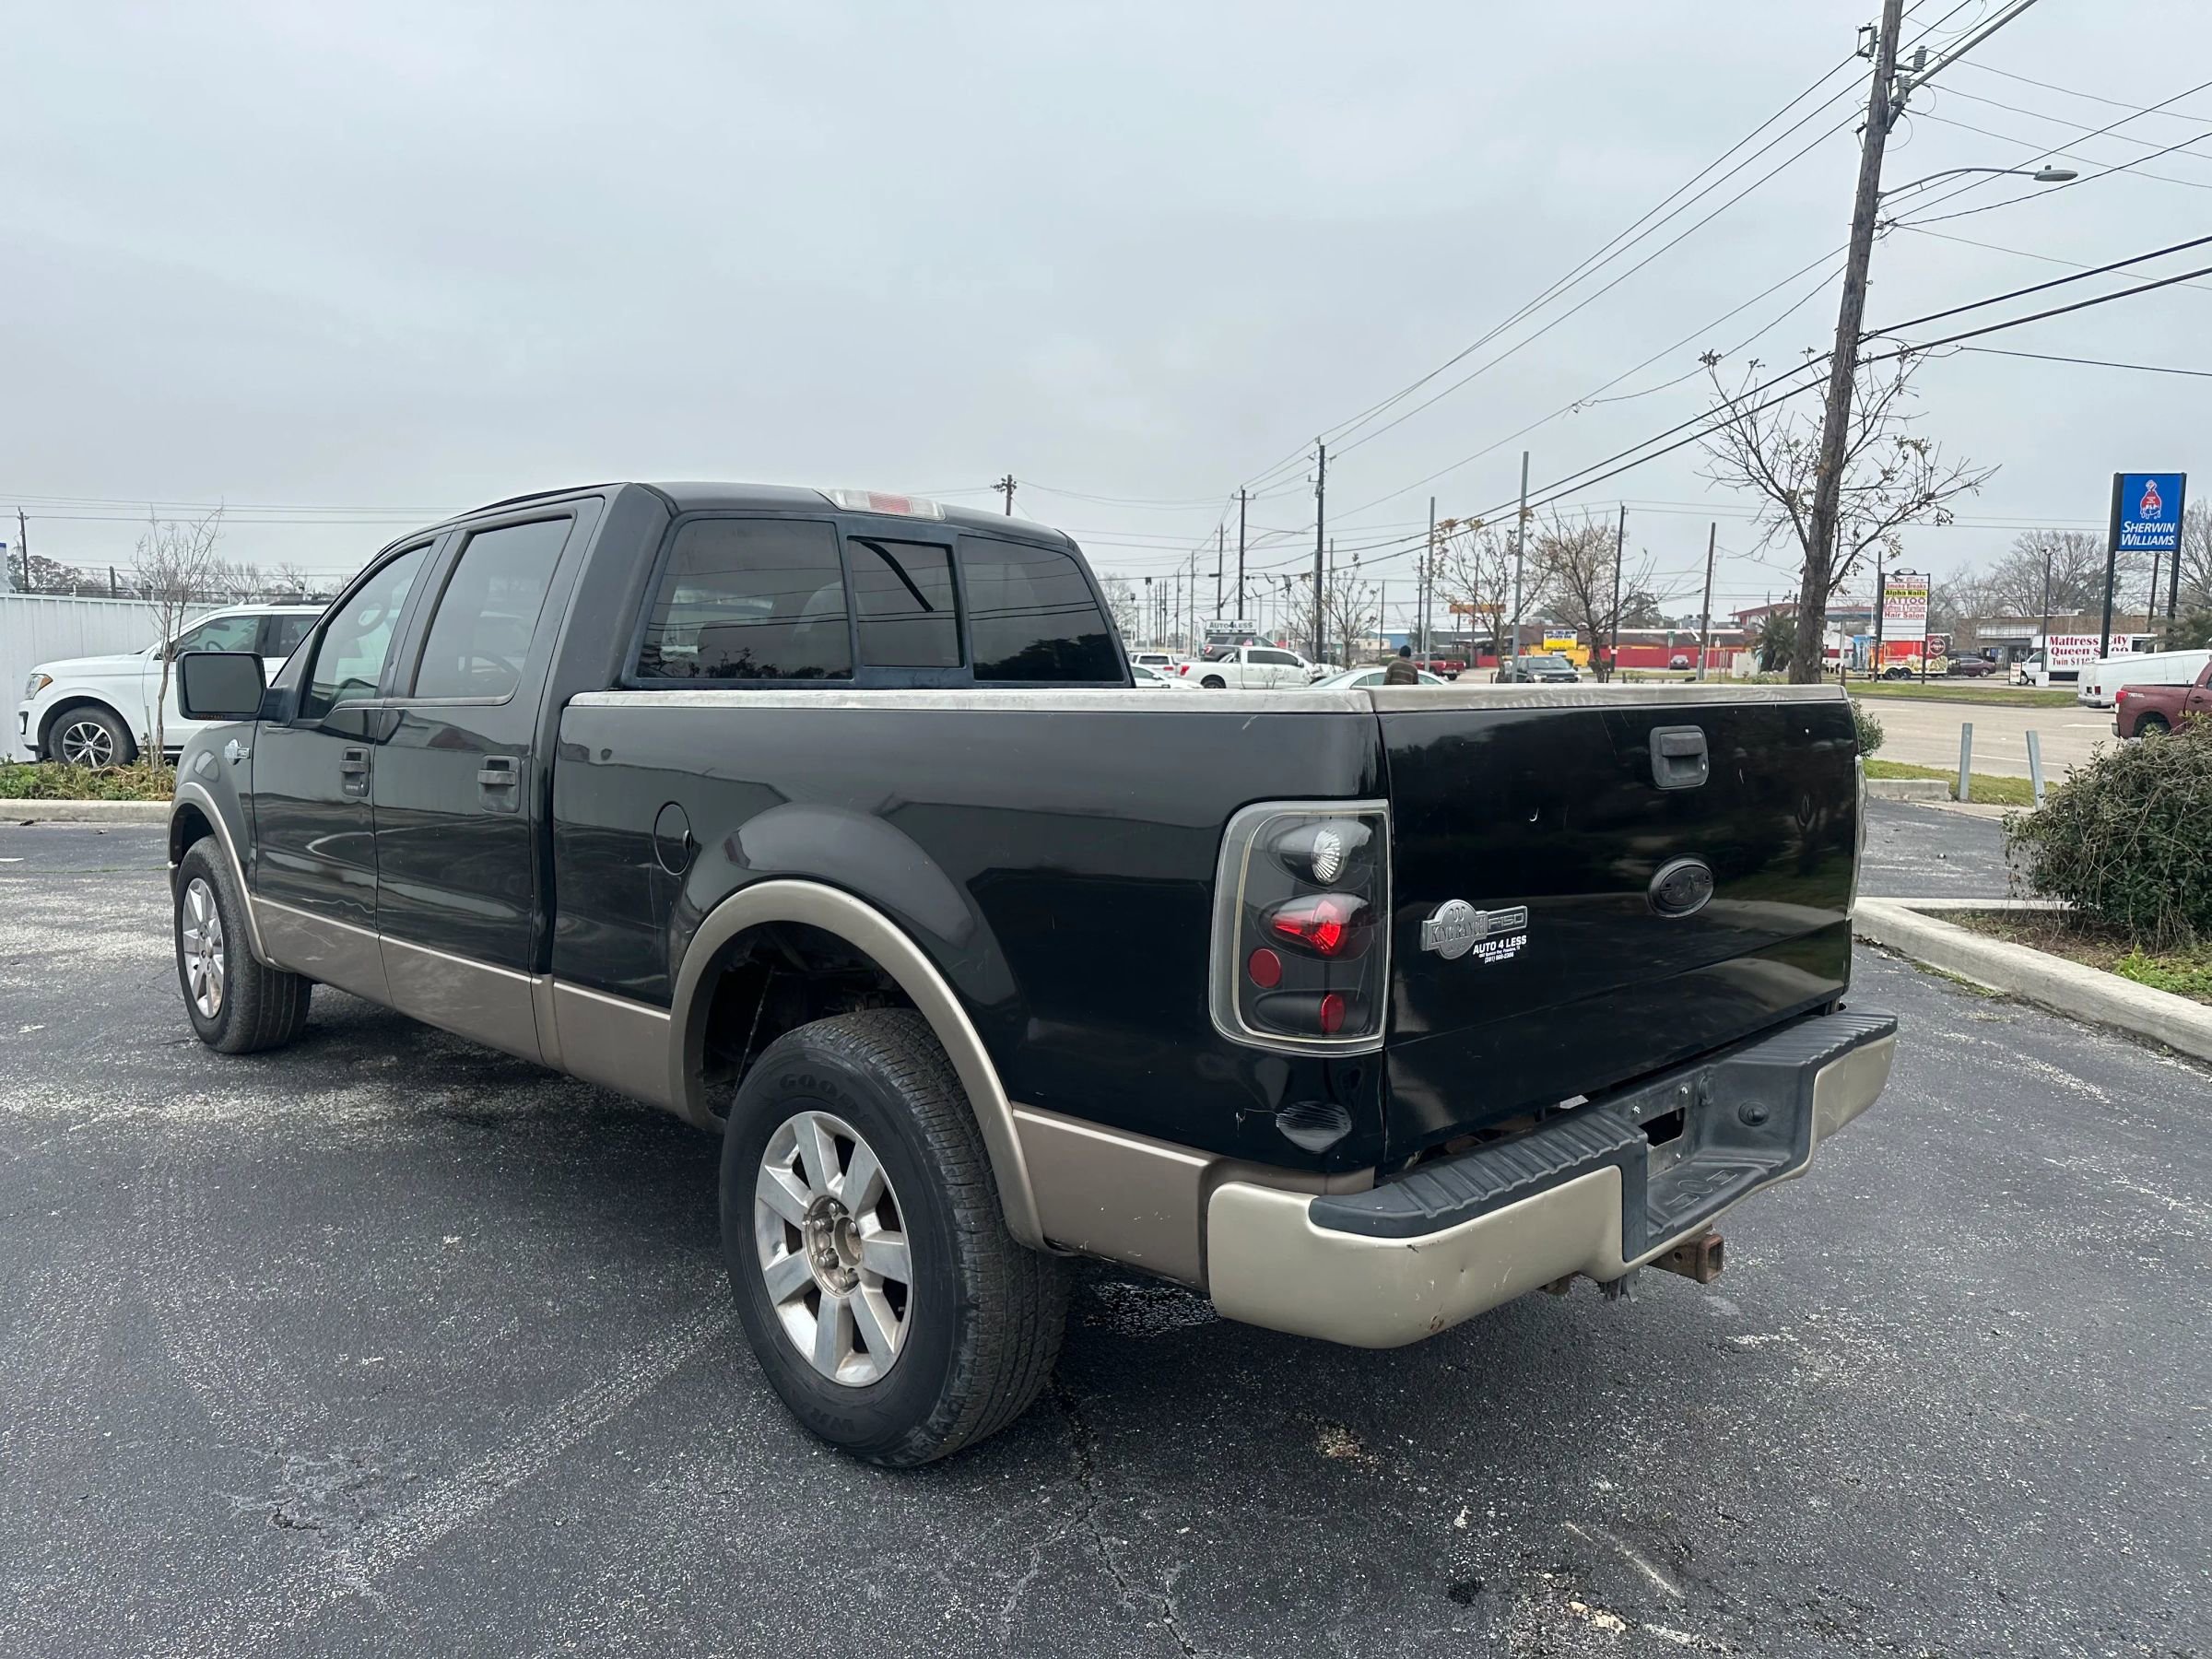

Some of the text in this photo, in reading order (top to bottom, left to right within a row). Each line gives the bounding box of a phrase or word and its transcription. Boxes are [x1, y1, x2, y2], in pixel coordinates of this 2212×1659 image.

[2122, 521, 2175, 534] SHERWIN
[2121, 534, 2175, 546] WILLIAMS
[2049, 636, 2099, 646] Mattress
[2051, 647, 2090, 656] Queen
[2053, 657, 2068, 665] Twin
[1431, 916, 1486, 944] KING RANCH
[1473, 941, 1497, 955] AUTO
[1498, 939, 1504, 949] 4
[1506, 935, 1527, 948] LESS
